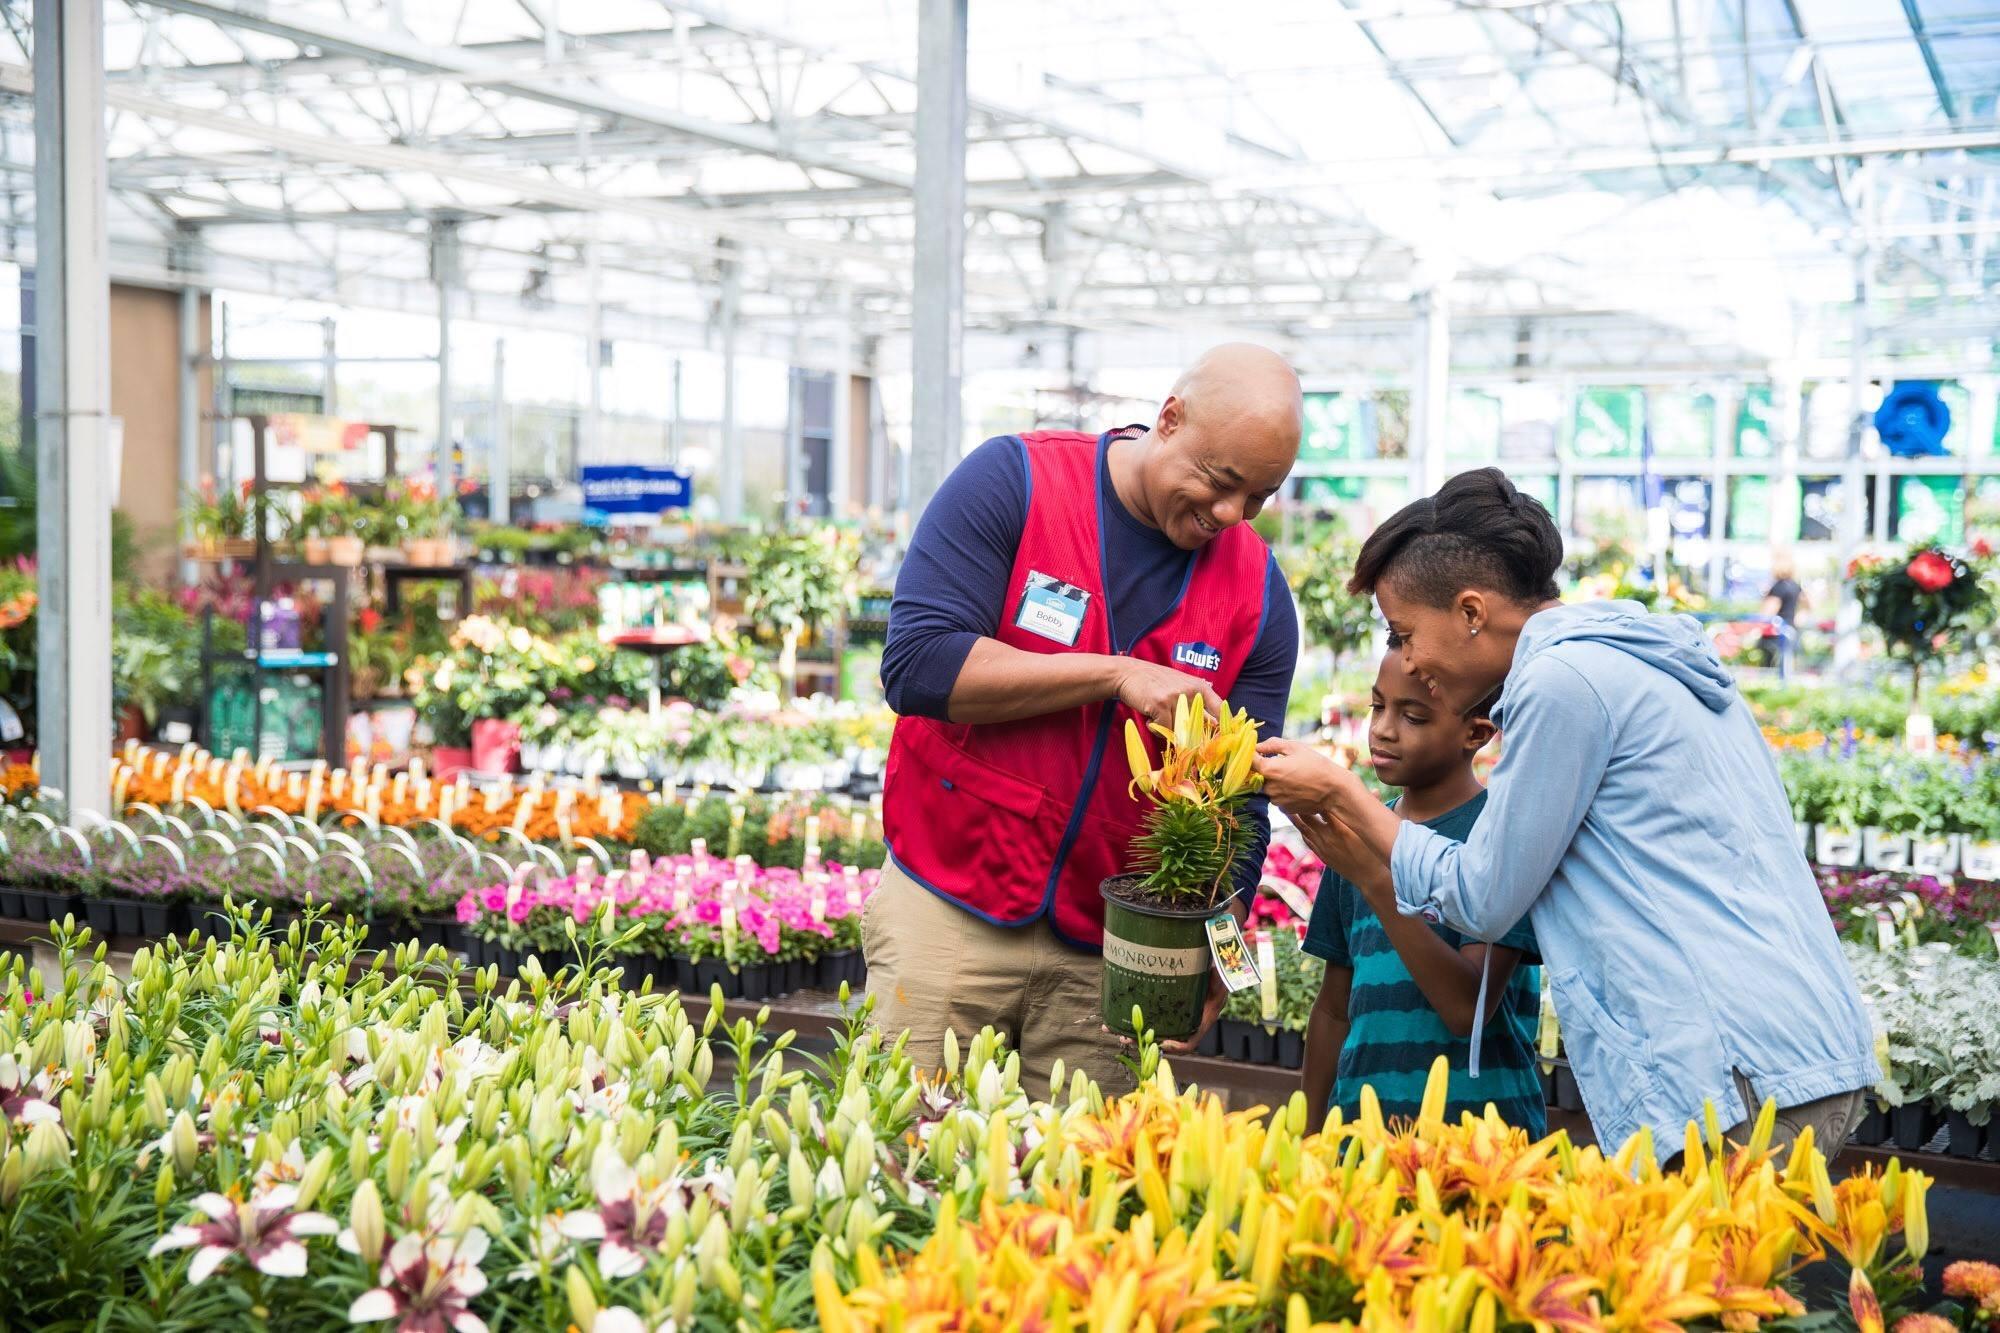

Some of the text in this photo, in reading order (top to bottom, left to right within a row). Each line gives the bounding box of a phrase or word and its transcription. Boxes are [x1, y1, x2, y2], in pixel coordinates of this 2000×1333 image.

[1036, 610, 1064, 627] Bobby
[1176, 646, 1220, 671] LOWE'S
[1110, 944, 1184, 969] MONROVIA
